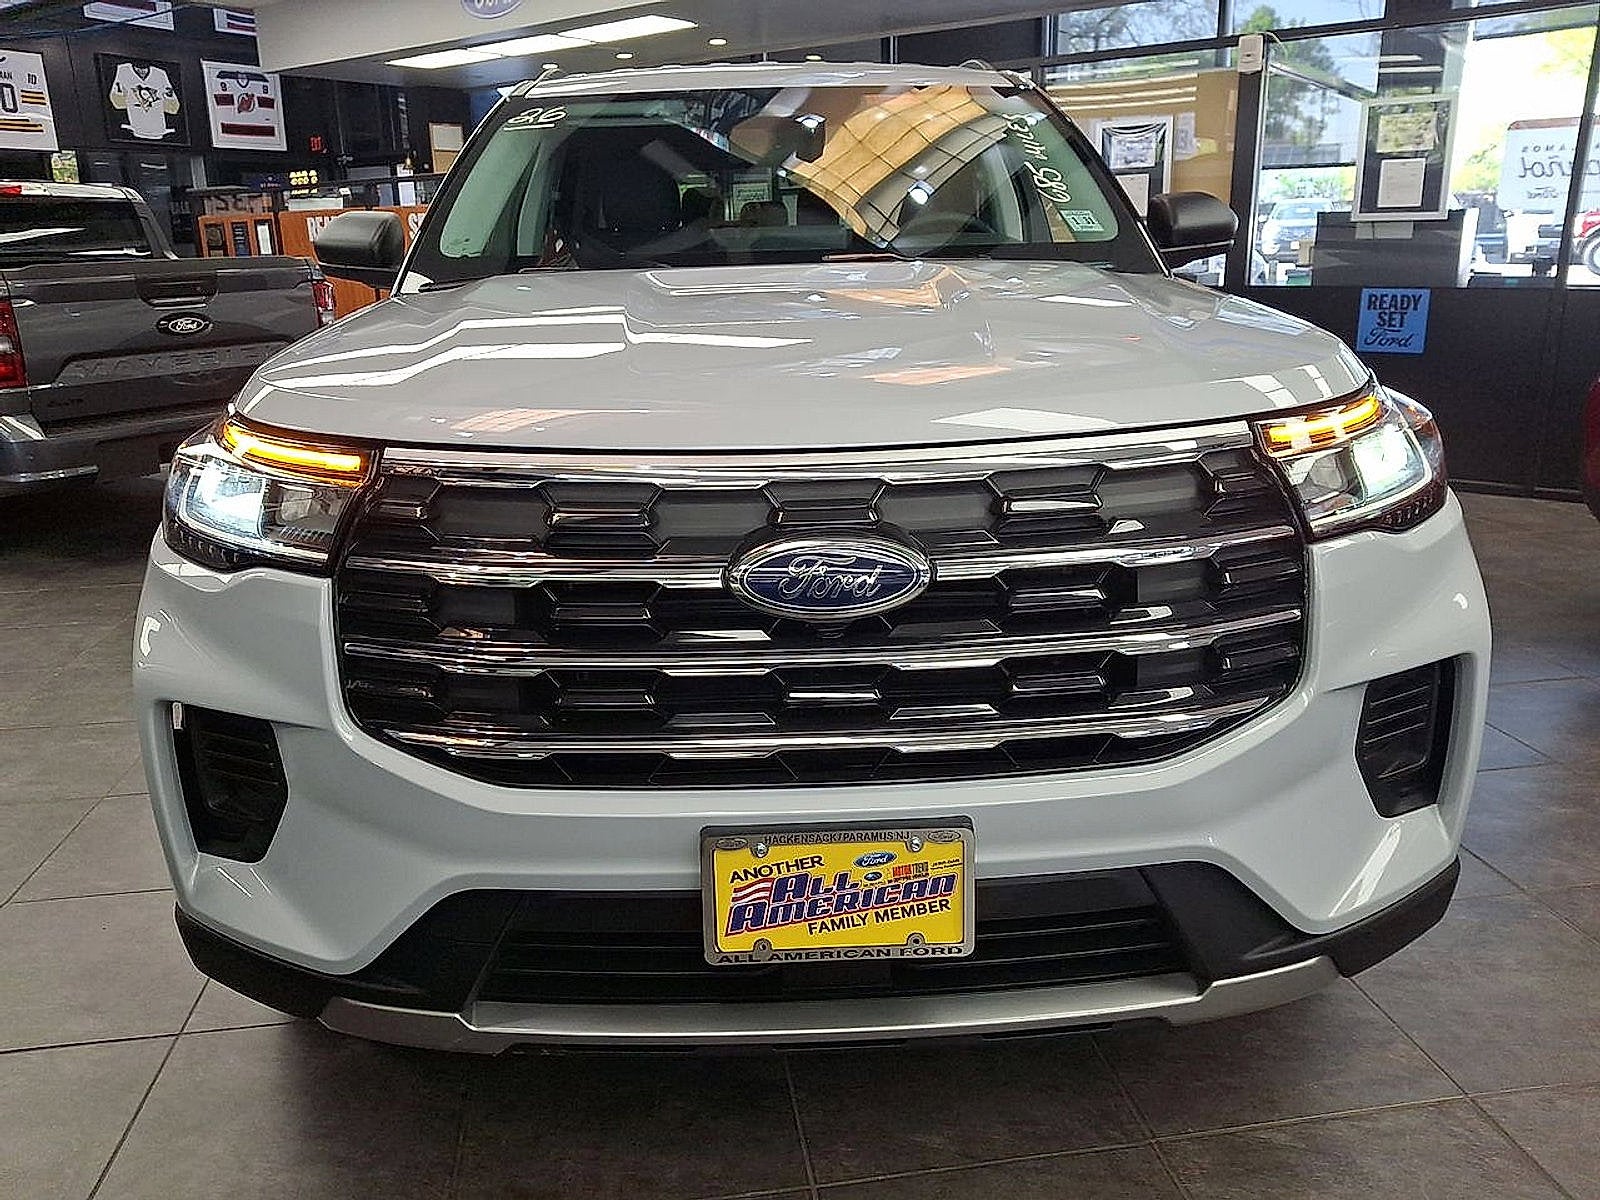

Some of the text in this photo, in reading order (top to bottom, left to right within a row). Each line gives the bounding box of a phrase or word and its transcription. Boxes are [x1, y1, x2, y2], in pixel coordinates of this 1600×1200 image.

[1367, 293, 1422, 311] READY
[173, 319, 198, 331] Ford
[1376, 311, 1408, 328] SET
[777, 555, 884, 600] Ford
[861, 853, 888, 866] Ford
[729, 855, 825, 884] ANOTHER
[771, 871, 861, 904] ALL
[807, 900, 952, 936] FAMILY MEMBER
[716, 946, 963, 964] ALL AMERICAN FORD
